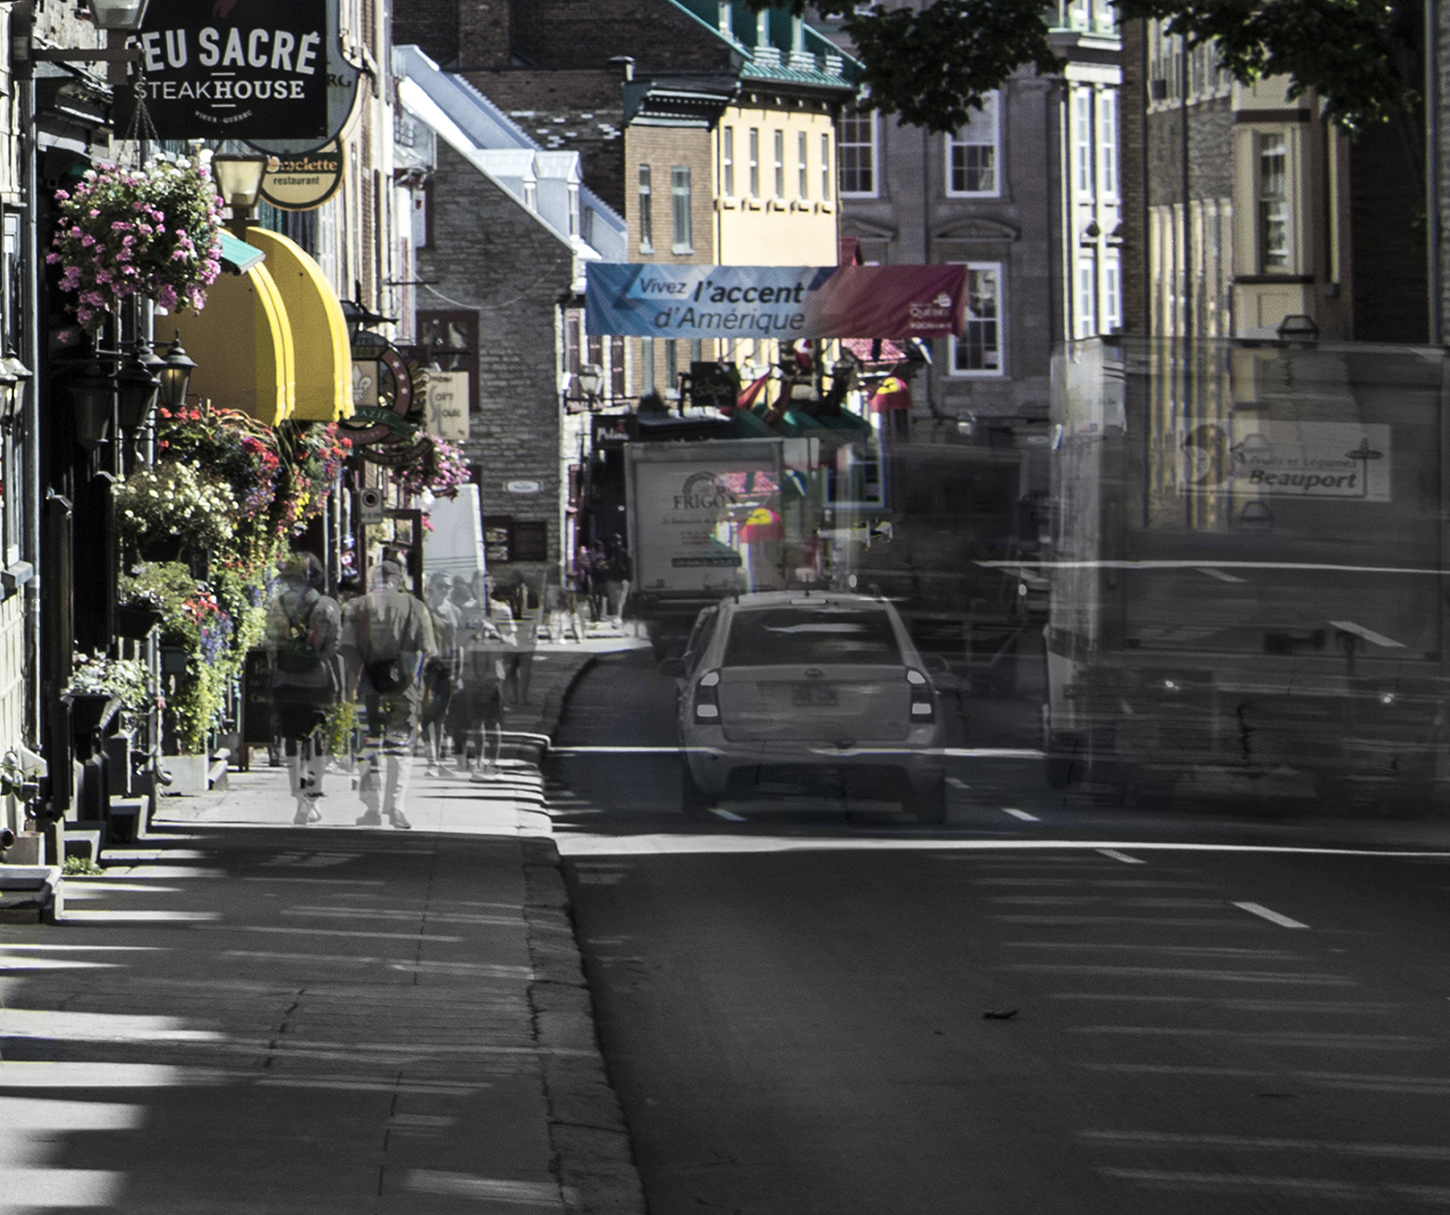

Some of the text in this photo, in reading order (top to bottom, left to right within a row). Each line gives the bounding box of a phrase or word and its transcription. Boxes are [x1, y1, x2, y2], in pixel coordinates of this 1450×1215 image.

[199, 27, 320, 76] SACRÉ
[134, 80, 305, 100] STEAKHOUSE
[273, 175, 320, 185] restaurant
[640, 278, 687, 294] Vivez
[1250, 469, 1357, 491] Beauport
